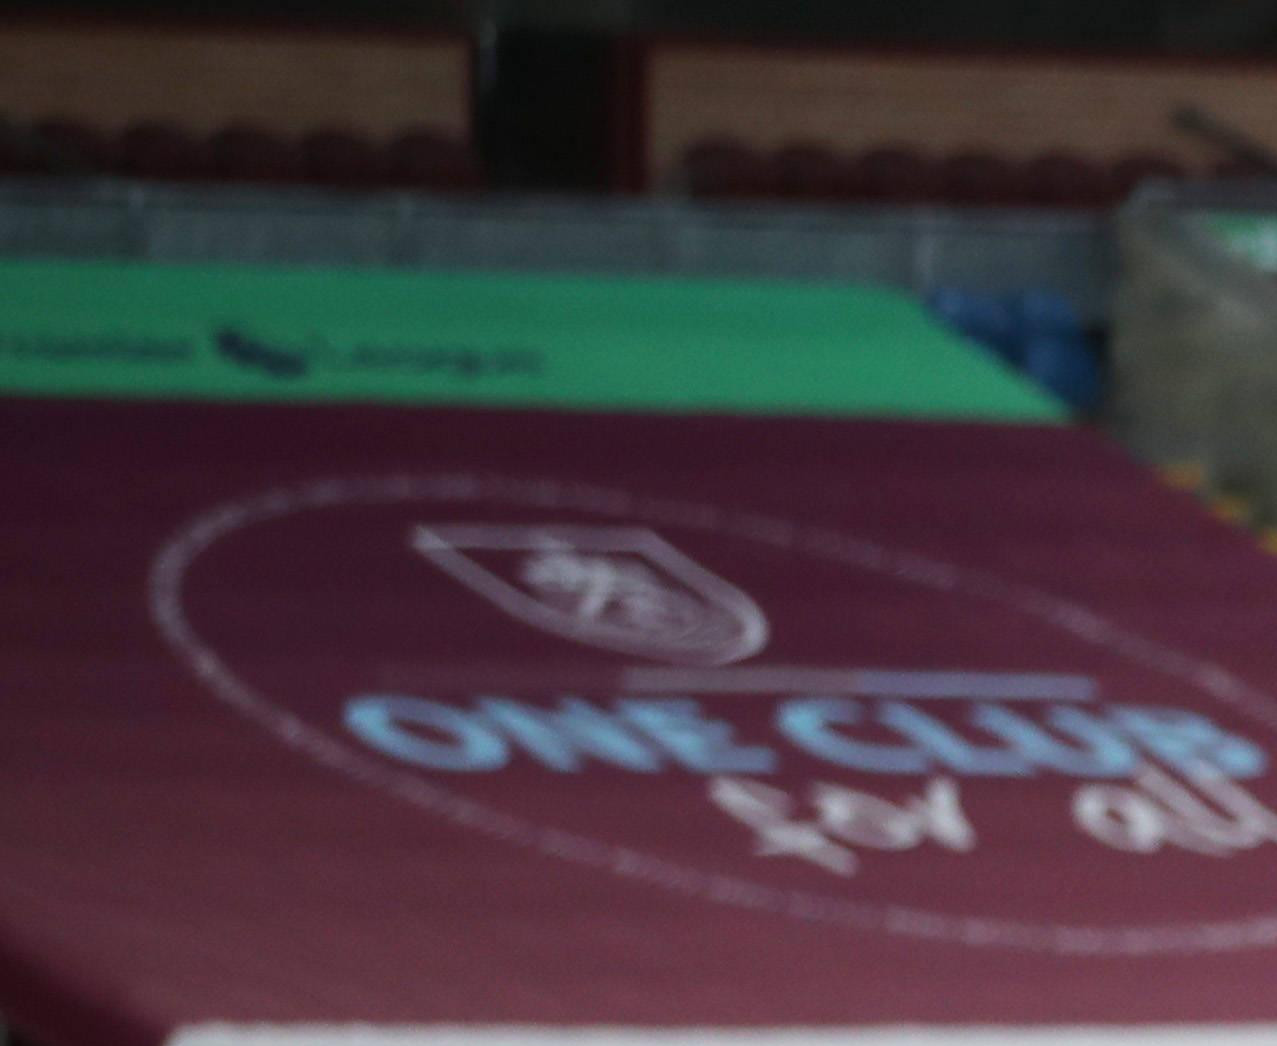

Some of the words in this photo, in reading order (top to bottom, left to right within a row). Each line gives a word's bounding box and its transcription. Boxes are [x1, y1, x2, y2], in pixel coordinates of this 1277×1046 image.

[344, 693, 777, 774] ONE
[777, 697, 1267, 779] CLUB
[708, 774, 977, 877] for
